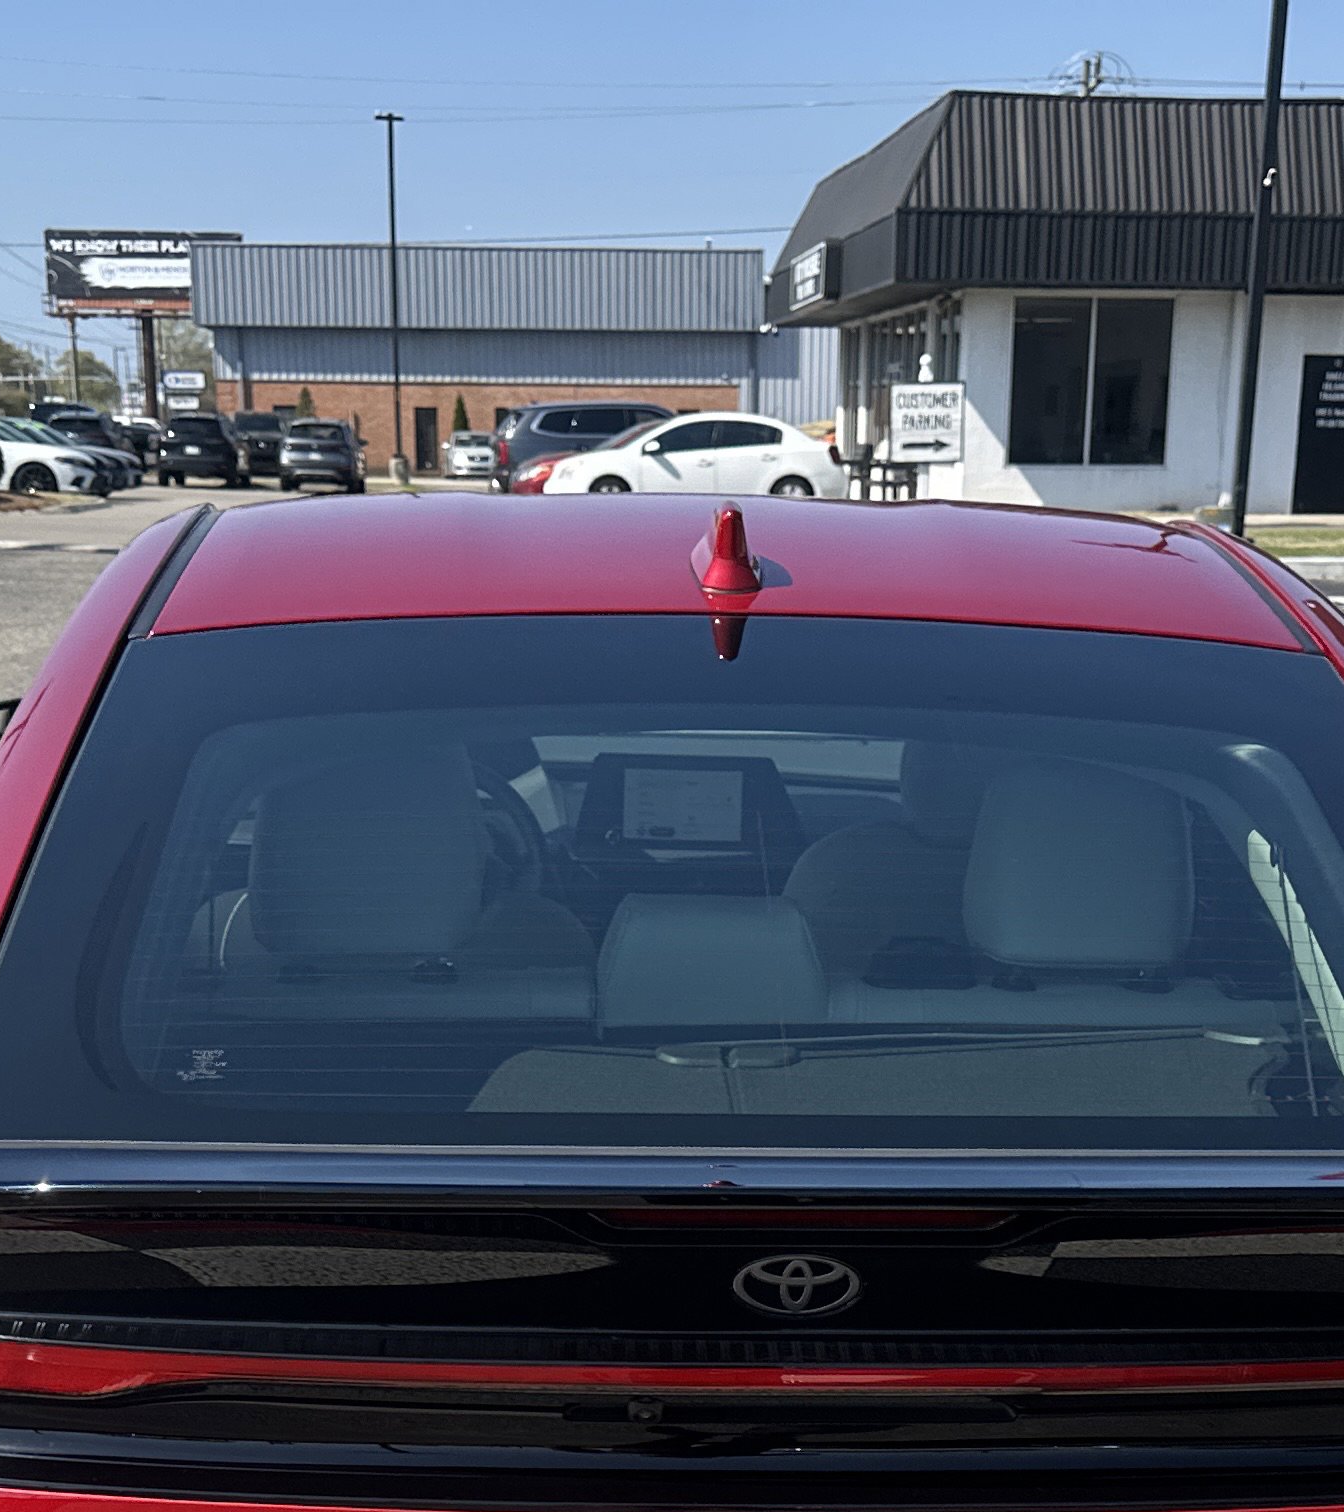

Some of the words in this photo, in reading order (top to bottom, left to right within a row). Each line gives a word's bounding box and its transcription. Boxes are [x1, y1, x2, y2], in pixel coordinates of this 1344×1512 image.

[74, 239, 119, 252] KNOW
[896, 391, 959, 409] CUSTOMER
[902, 413, 953, 431] PARKING
